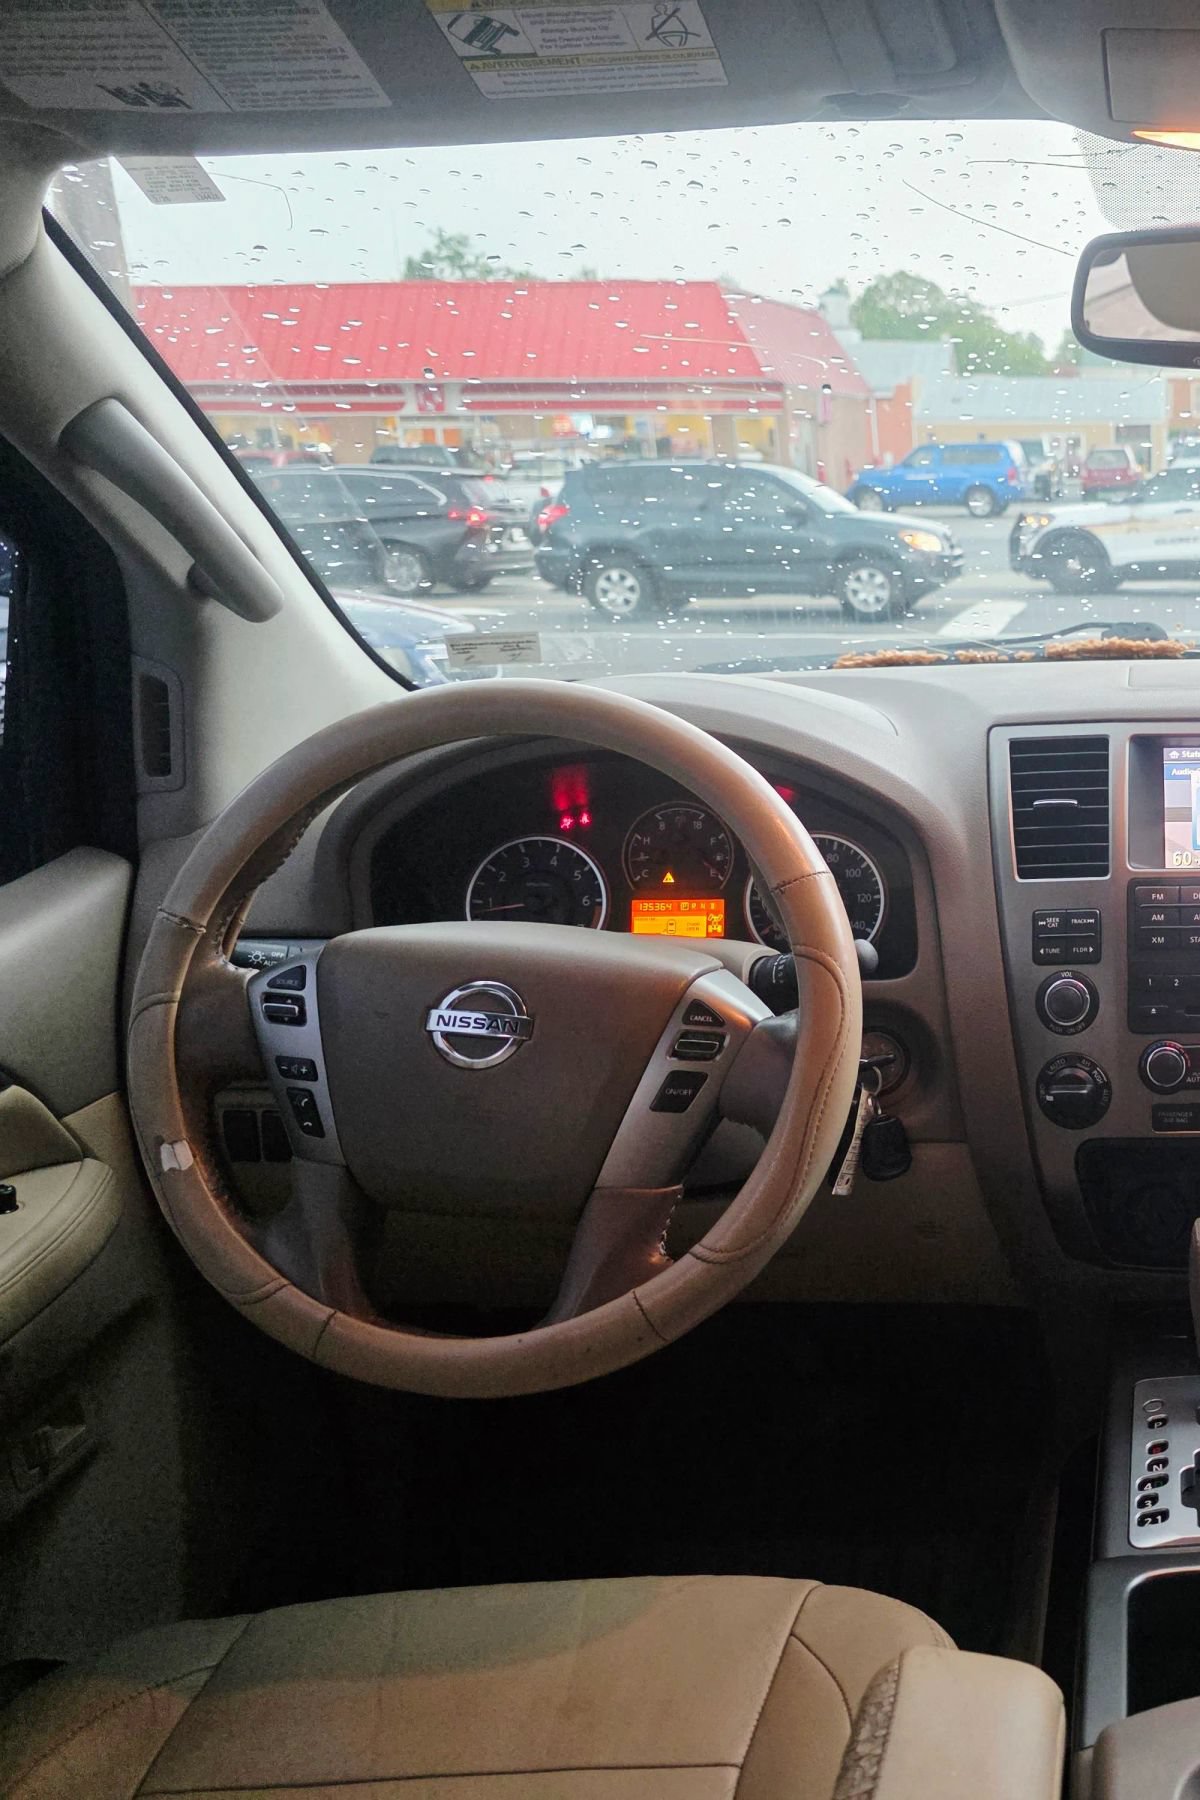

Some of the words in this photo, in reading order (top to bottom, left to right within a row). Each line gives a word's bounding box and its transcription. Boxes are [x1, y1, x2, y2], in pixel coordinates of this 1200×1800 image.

[522, 857, 531, 868] 3
[550, 855, 558, 867] 4
[827, 853, 840, 864] 80
[1173, 851, 1193, 866] 60
[499, 871, 507, 882] 2
[574, 870, 582, 881] 5
[845, 868, 862, 879] 100
[582, 896, 590, 906] 6
[857, 893, 872, 904] 120
[640, 902, 672, 911] 135364
[1151, 936, 1165, 944] XM
[1148, 978, 1152, 986] 1
[436, 1014, 520, 1034] NISSAN
[1155, 1421, 1162, 1430] P
[1153, 1464, 1163, 1472] N
[1144, 1483, 1153, 1491] 4
[1144, 1500, 1153, 1509] 3
[1156, 1515, 1162, 1523] 1
